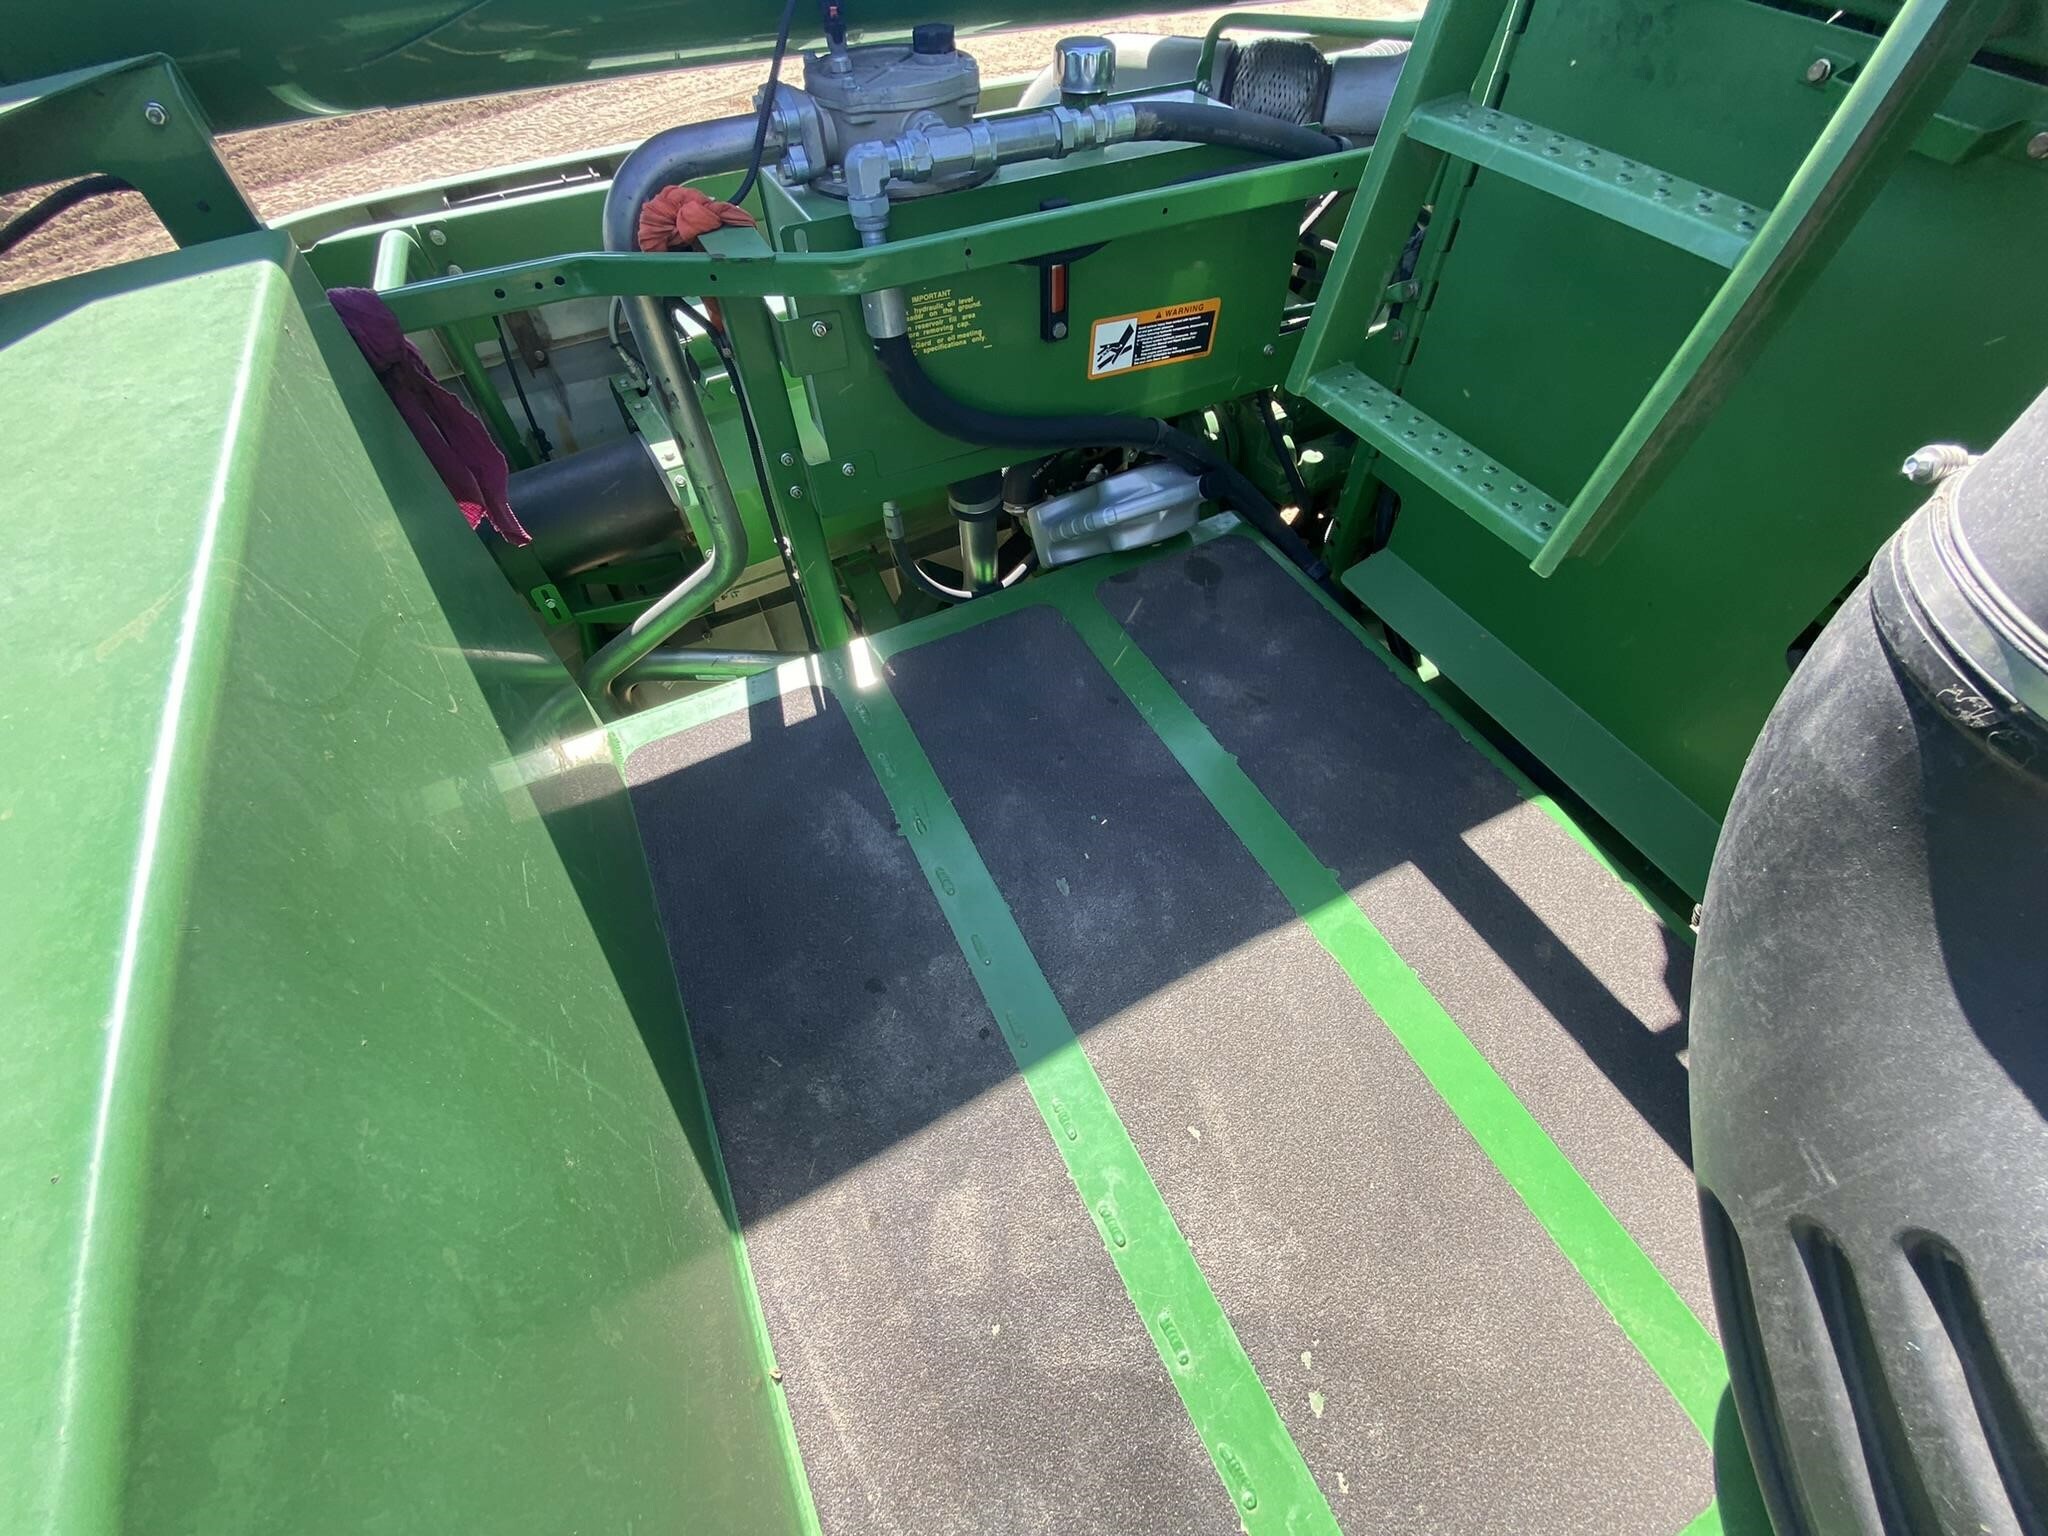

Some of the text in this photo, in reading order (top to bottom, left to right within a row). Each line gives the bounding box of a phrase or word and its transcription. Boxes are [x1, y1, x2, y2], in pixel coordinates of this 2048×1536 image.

[912, 289, 951, 303] IMPORTANT
[914, 303, 944, 314] hydraulic
[958, 296, 973, 304] level
[1165, 303, 1204, 317] WARNING
[915, 320, 944, 330] reservoir
[923, 324, 953, 335] removing
[923, 340, 967, 354] specifications
